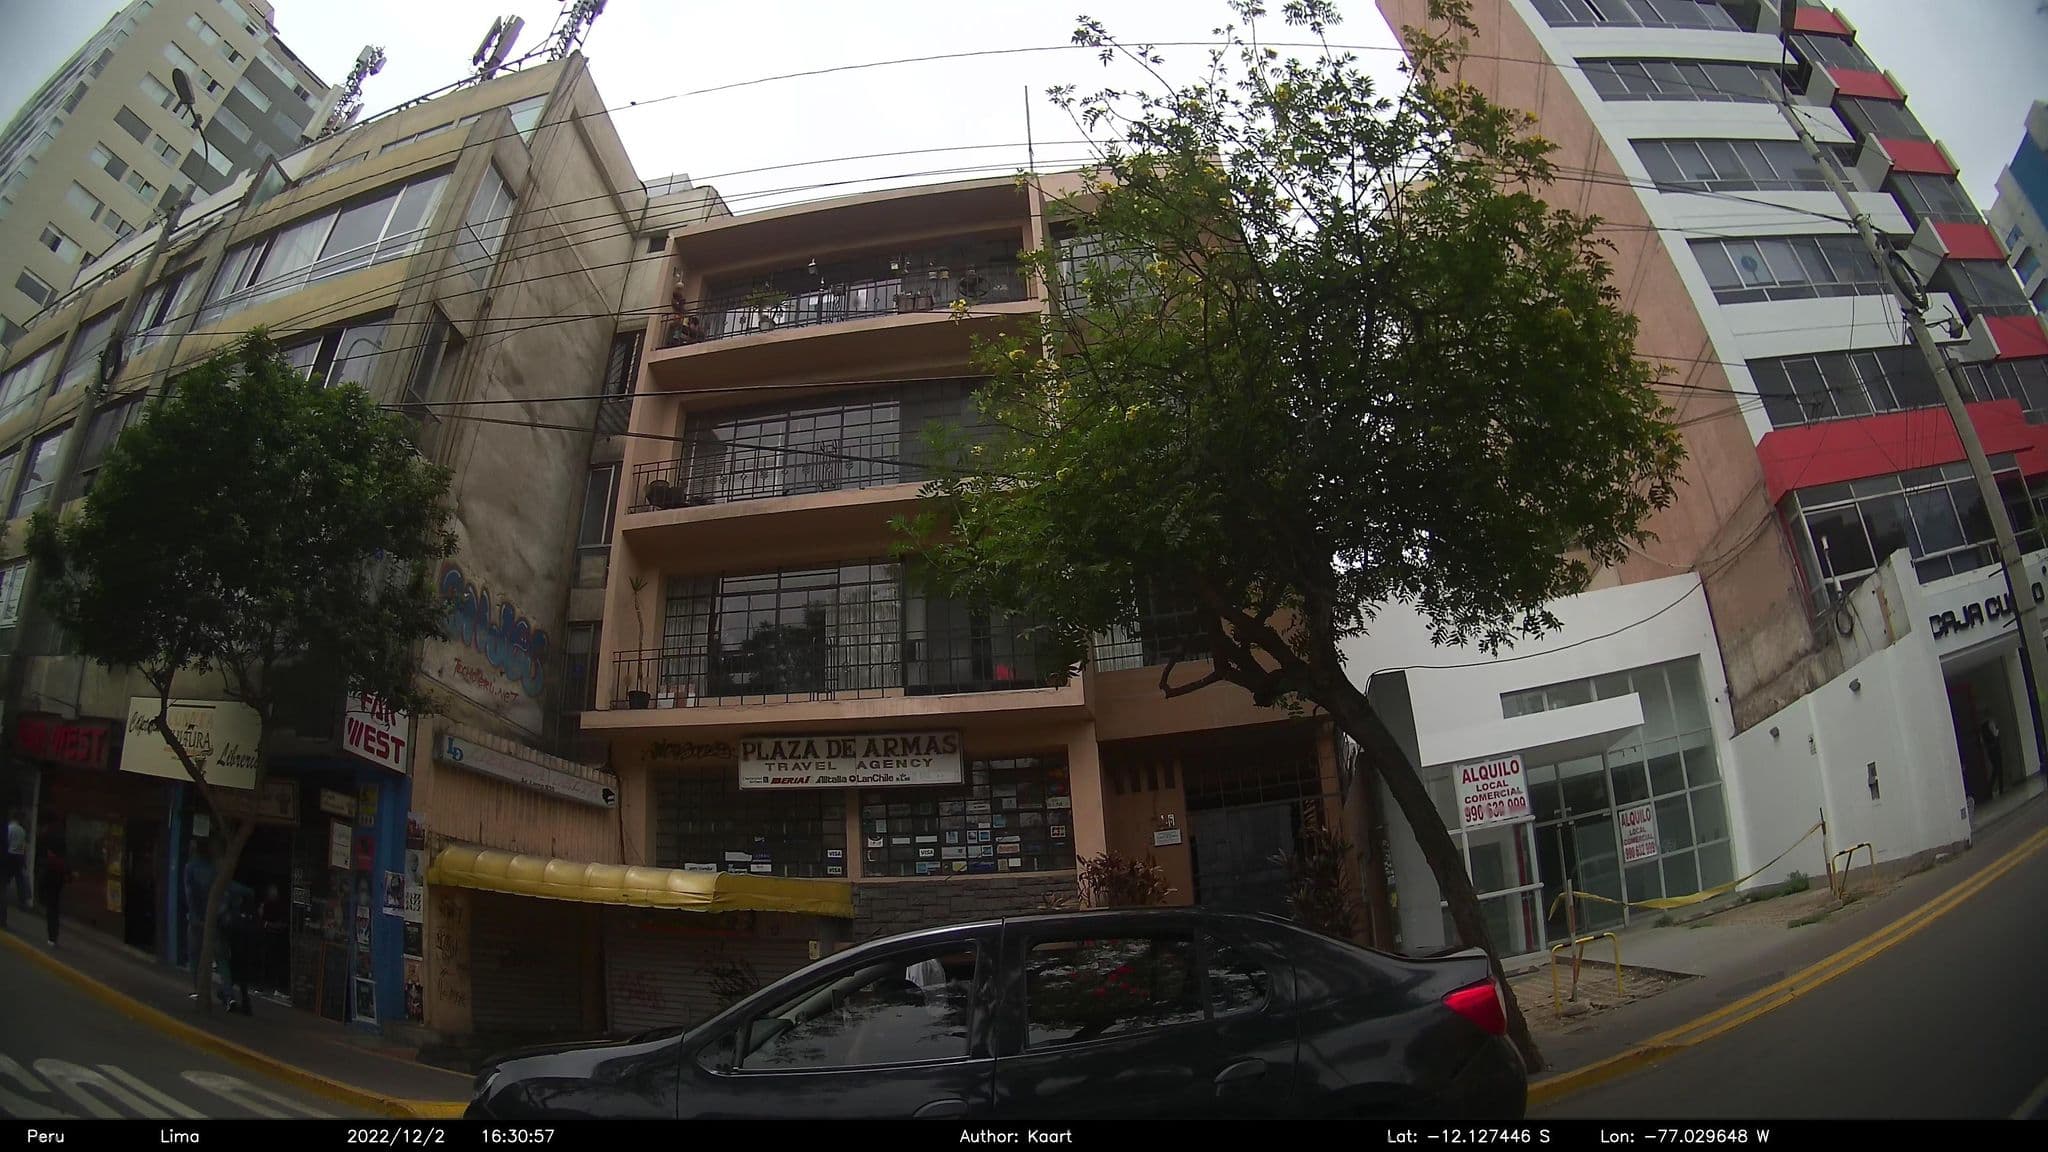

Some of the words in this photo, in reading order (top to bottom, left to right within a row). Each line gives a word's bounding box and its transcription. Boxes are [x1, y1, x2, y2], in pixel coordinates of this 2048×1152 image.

[1929, 602, 1985, 640] CAJA
[1985, 581, 2046, 621] CUO
[348, 716, 405, 765] WEST
[741, 739, 820, 762] PLAZA
[826, 738, 857, 759] DE
[862, 734, 958, 758] ARMAS
[765, 762, 837, 772] TRAVEL
[856, 758, 933, 770] AGENCY
[1462, 760, 1520, 784] ALQUILO
[815, 776, 847, 784] Alitalia
[857, 773, 894, 783] LanChile
[1476, 780, 1509, 792] LOCAL
[1464, 787, 1523, 804] COMERCIAL
[1621, 808, 1651, 826] ALQUILO
[1624, 833, 1654, 846] COMERCIAL
[1629, 826, 1647, 836] LOCAL
